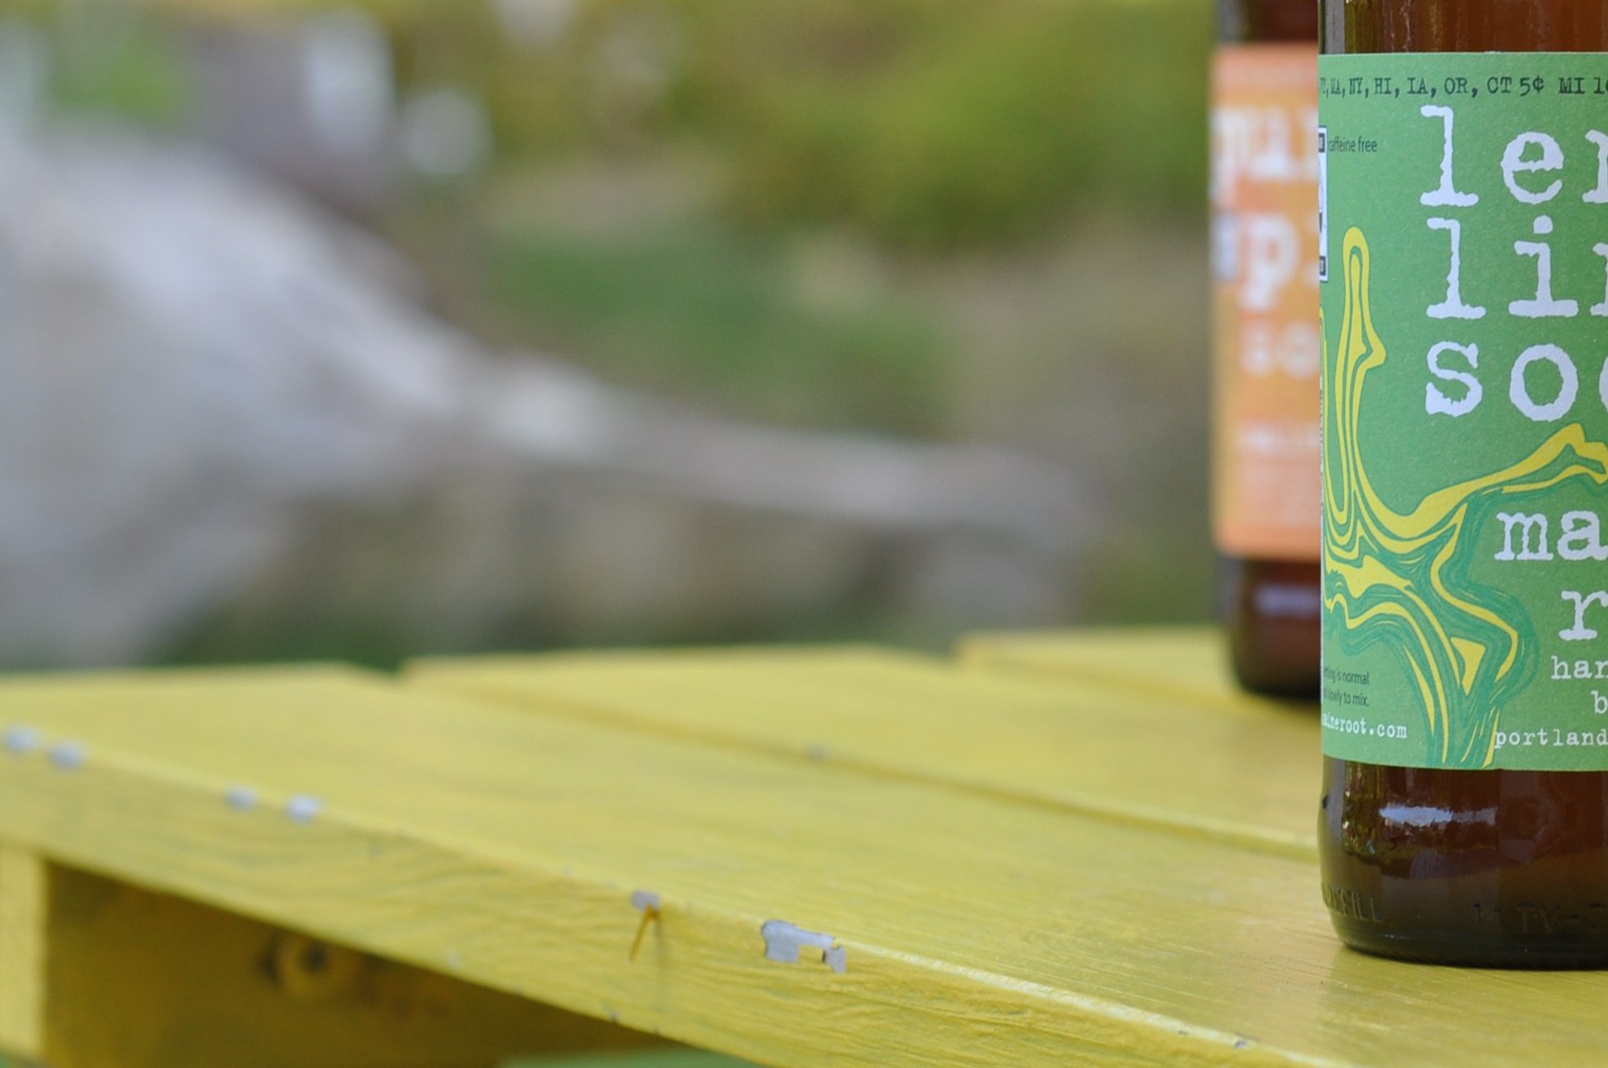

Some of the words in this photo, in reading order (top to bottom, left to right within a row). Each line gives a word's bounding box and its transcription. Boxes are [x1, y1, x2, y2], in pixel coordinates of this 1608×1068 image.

[1348, 77, 1370, 98] NY,
[1373, 77, 1400, 98] HI,
[1407, 77, 1437, 99] IA,
[1444, 77, 1479, 99] OR,
[1486, 76, 1512, 95] CT
[1519, 75, 1545, 97] 5¢
[1558, 76, 1586, 95] MI
[1357, 135, 1378, 153] free
[1342, 671, 1369, 685] normal
[1343, 692, 1352, 705] to
